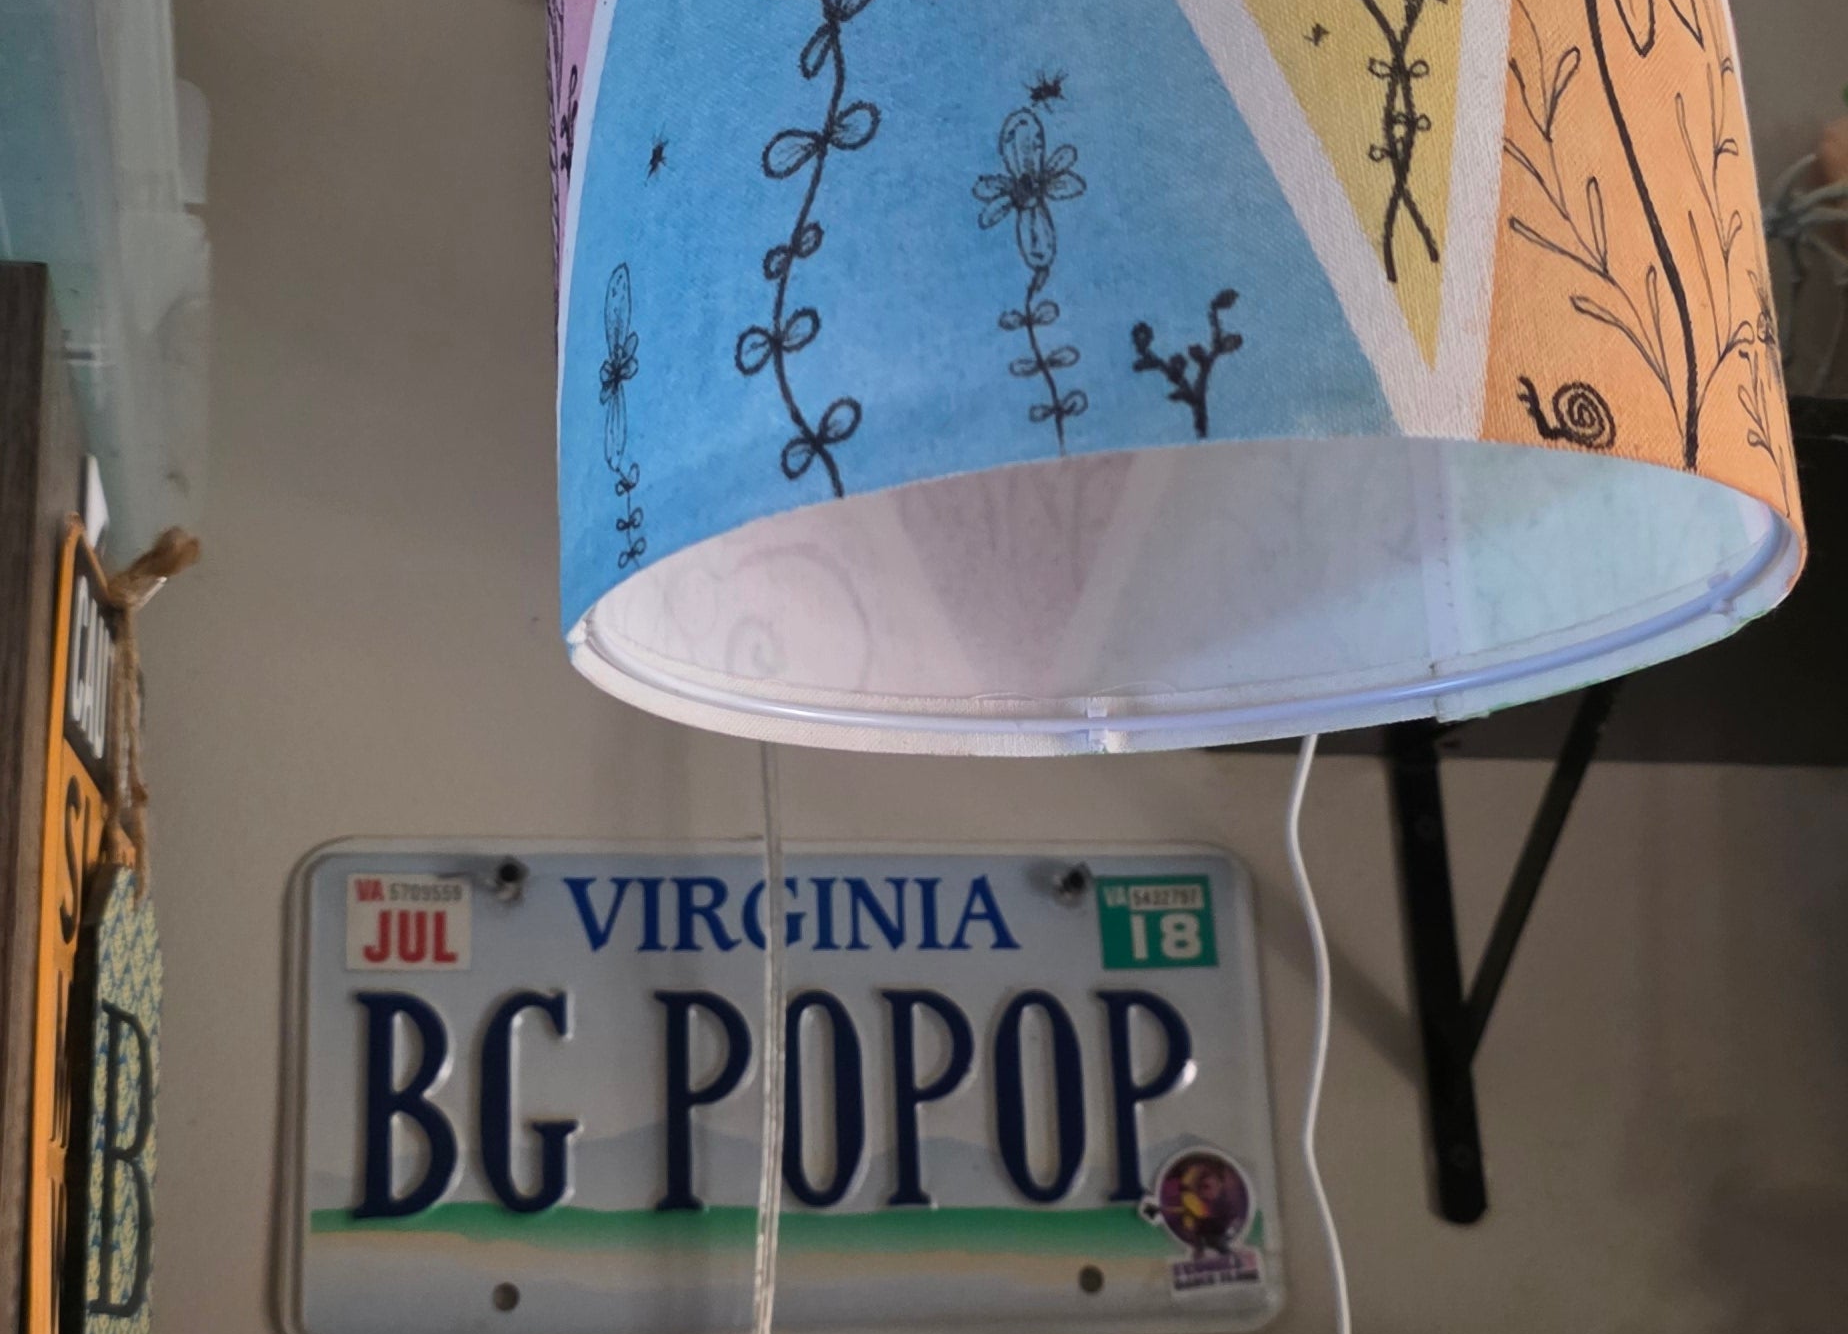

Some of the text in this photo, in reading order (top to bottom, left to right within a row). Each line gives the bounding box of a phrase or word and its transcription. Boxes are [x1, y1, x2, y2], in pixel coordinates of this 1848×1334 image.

[354, 879, 384, 902] VA
[561, 874, 1022, 953] VIRGINIA
[1103, 885, 1127, 907] VA
[362, 909, 458, 964] JUL
[1130, 912, 1203, 961] 18
[349, 987, 1197, 1221] BG POPOP
[89, 997, 152, 1319] B
